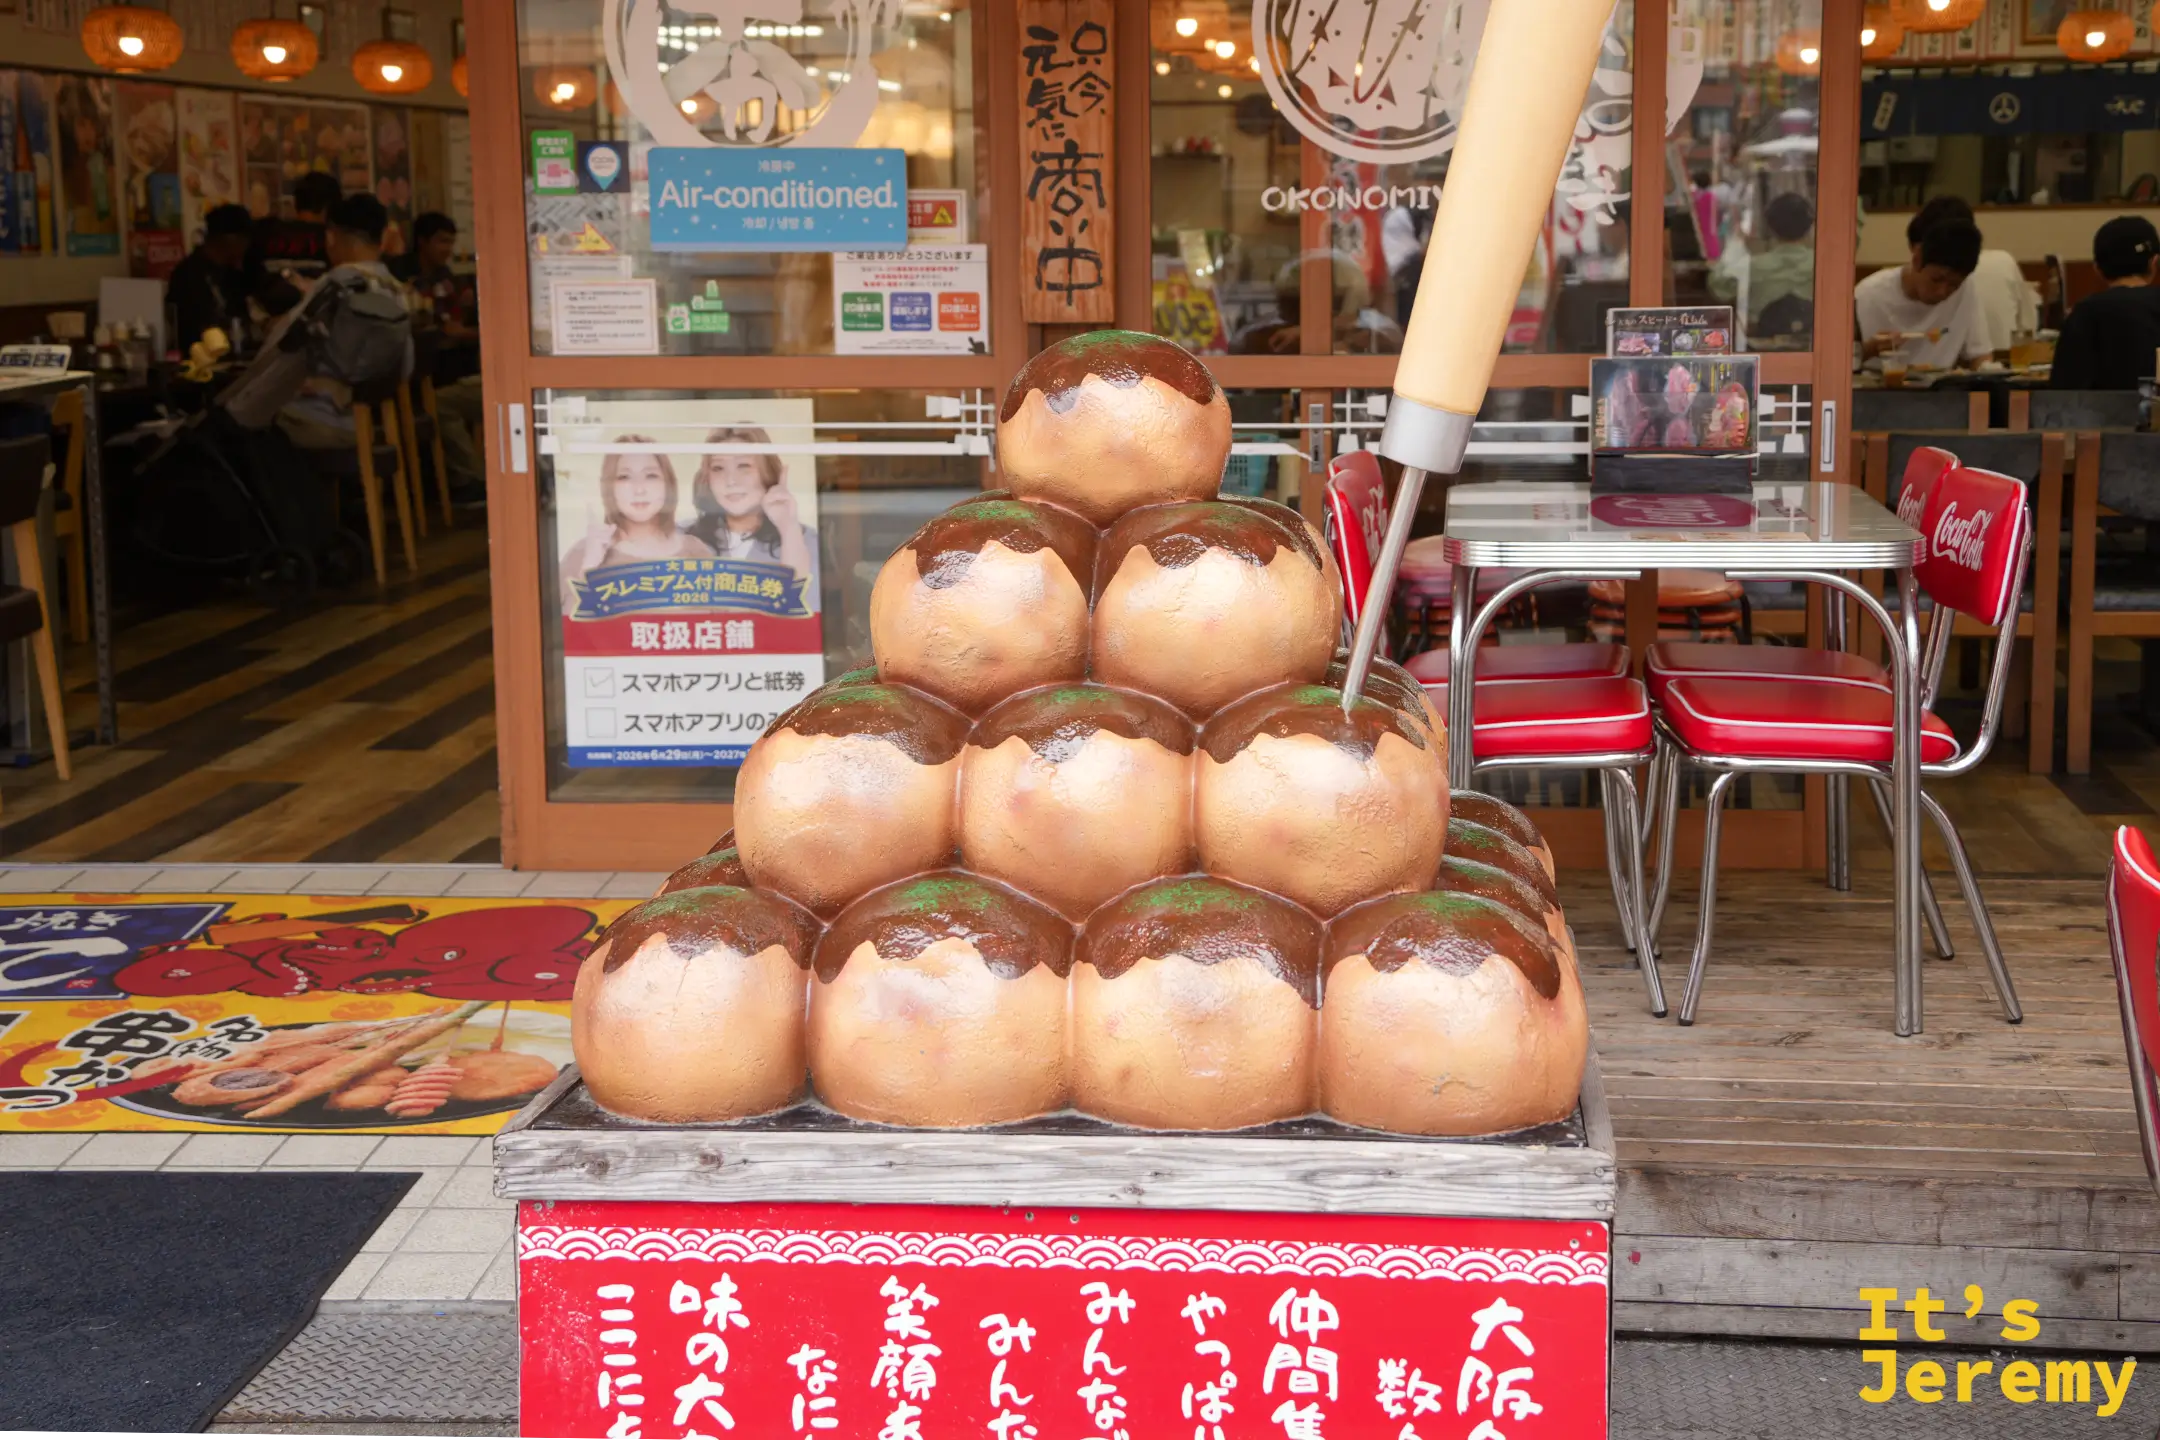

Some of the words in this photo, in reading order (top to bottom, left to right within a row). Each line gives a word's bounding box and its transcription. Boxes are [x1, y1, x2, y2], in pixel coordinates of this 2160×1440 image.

[1069, 20, 1112, 115] 只今
[658, 179, 899, 209] Air-conditioned.
[1933, 501, 1994, 571] Coca-Cola
[596, 572, 784, 601] プレミアム付商品券
[631, 620, 754, 650] 取扱店舗
[622, 671, 805, 693] スマホアプリと紙券
[669, 1272, 750, 1440] 味の大
